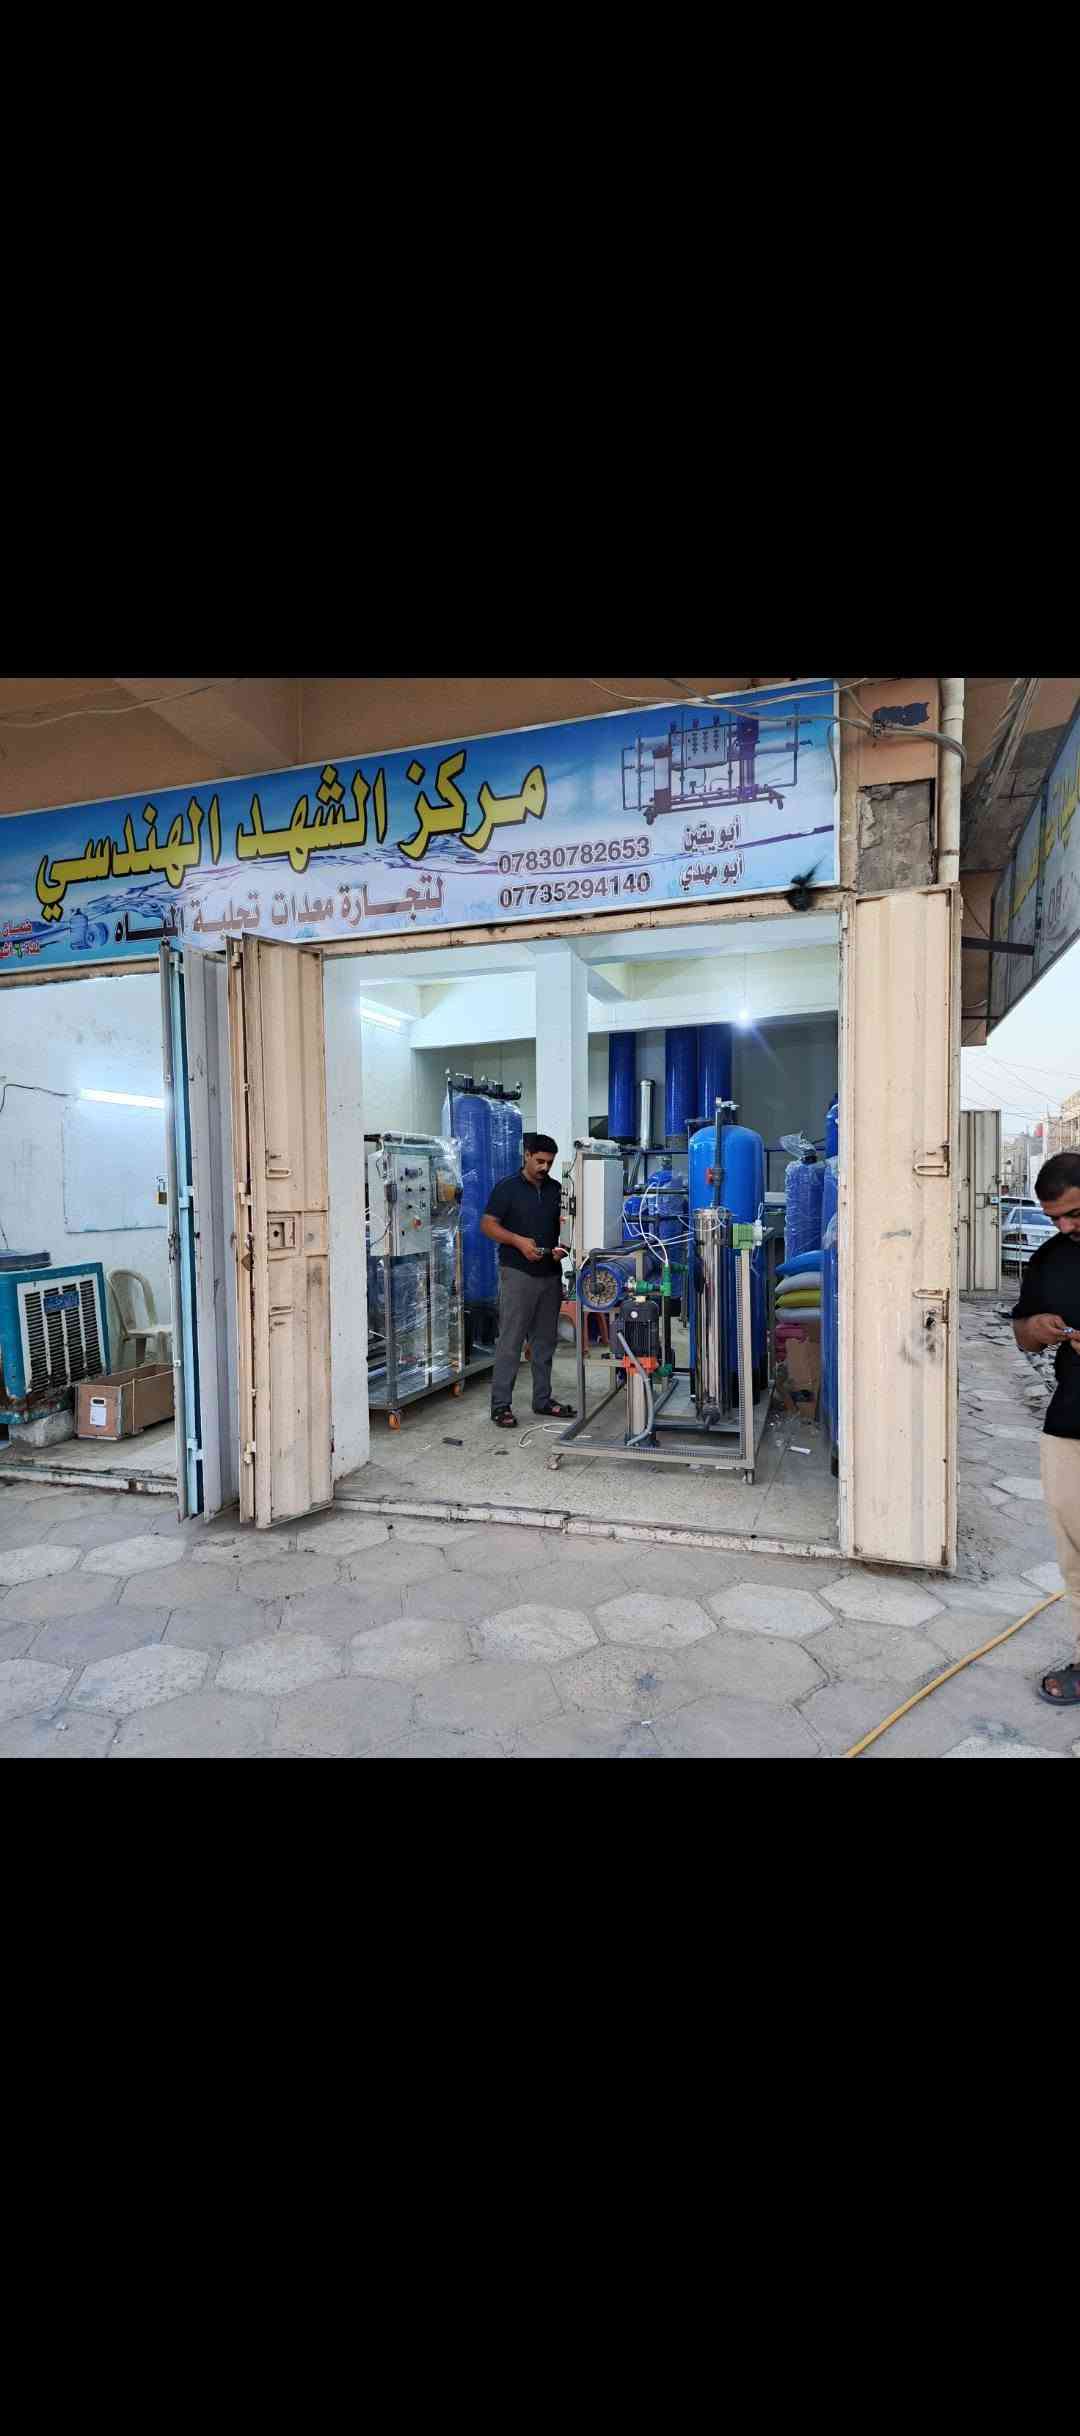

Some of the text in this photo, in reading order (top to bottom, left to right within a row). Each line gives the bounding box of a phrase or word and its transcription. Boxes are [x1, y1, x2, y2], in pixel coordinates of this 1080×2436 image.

[35, 750, 548, 922] مركز الشهد الهندسي
[498, 836, 651, 875] 07830782653
[499, 871, 651, 908] 07735294140
[681, 863, 718, 891] مهدي
